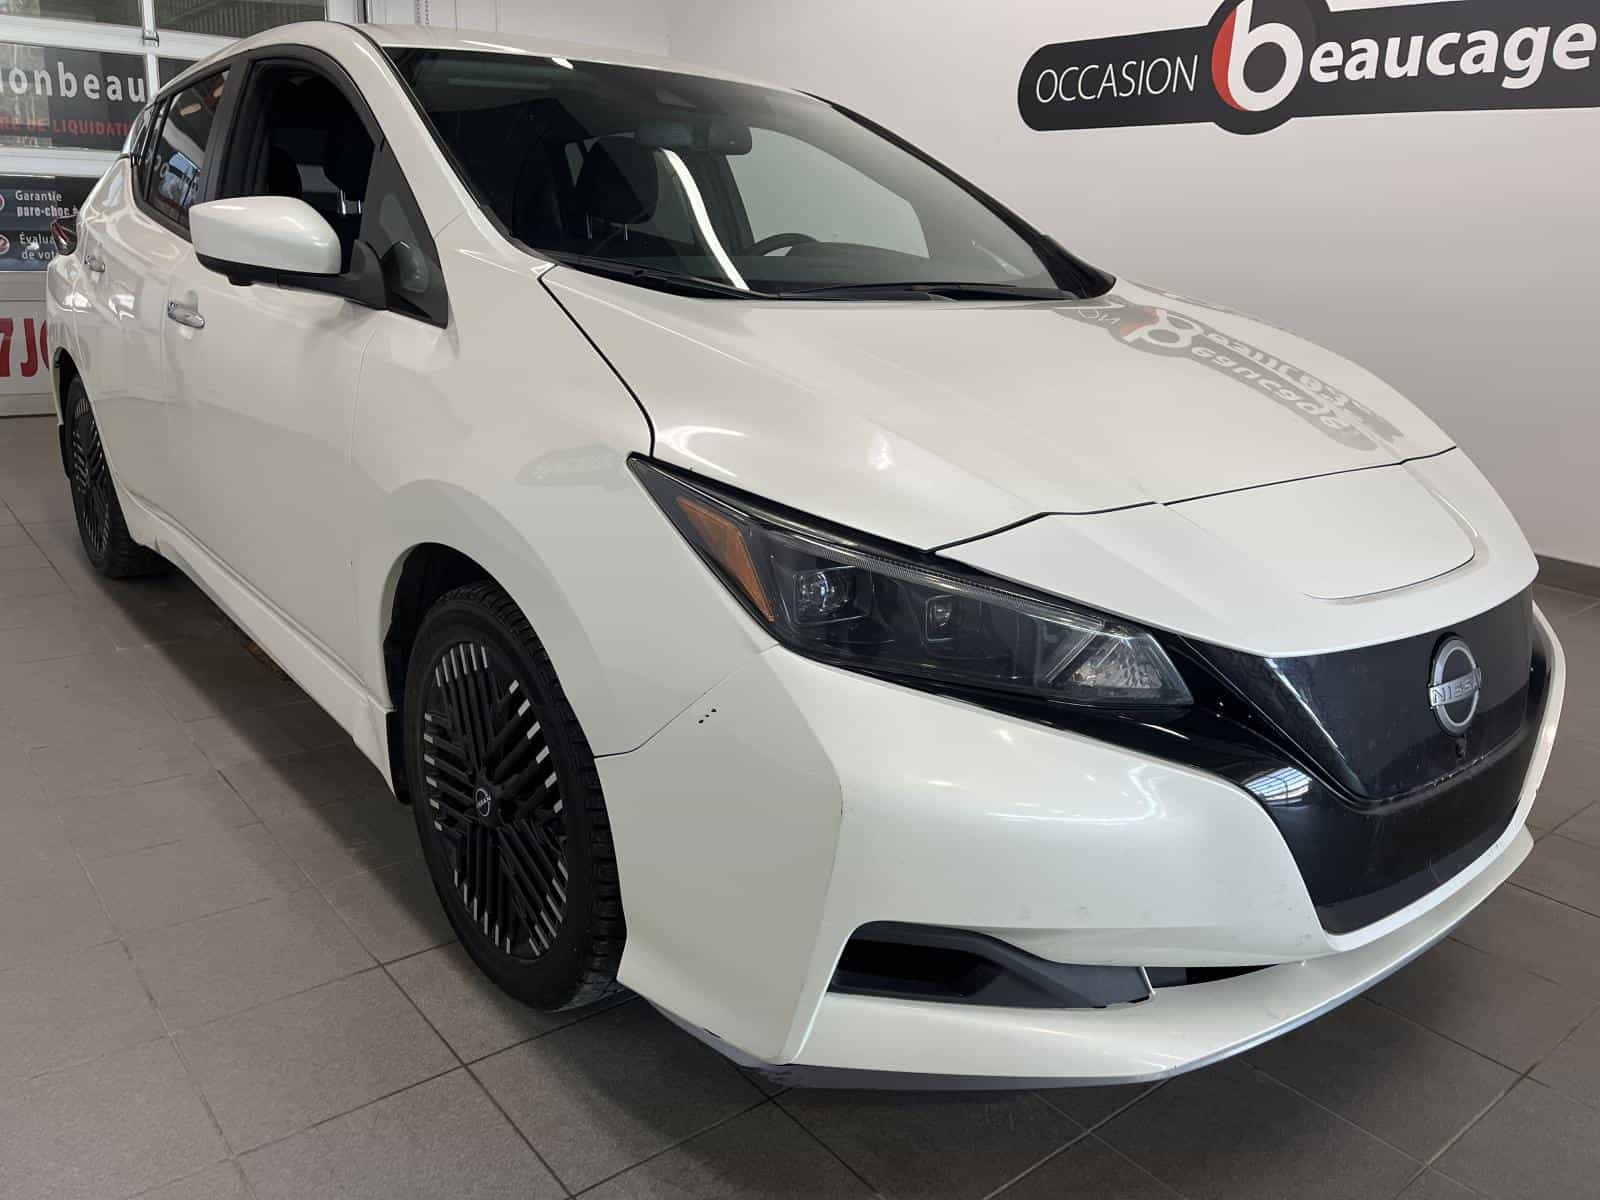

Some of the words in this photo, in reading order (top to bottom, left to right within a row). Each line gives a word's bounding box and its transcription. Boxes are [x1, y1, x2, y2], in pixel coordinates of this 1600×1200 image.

[1035, 54, 1199, 104] OCCASION
[15, 190, 63, 201] Garantie
[16, 205, 71, 217] pare-choc
[21, 248, 35, 260] de
